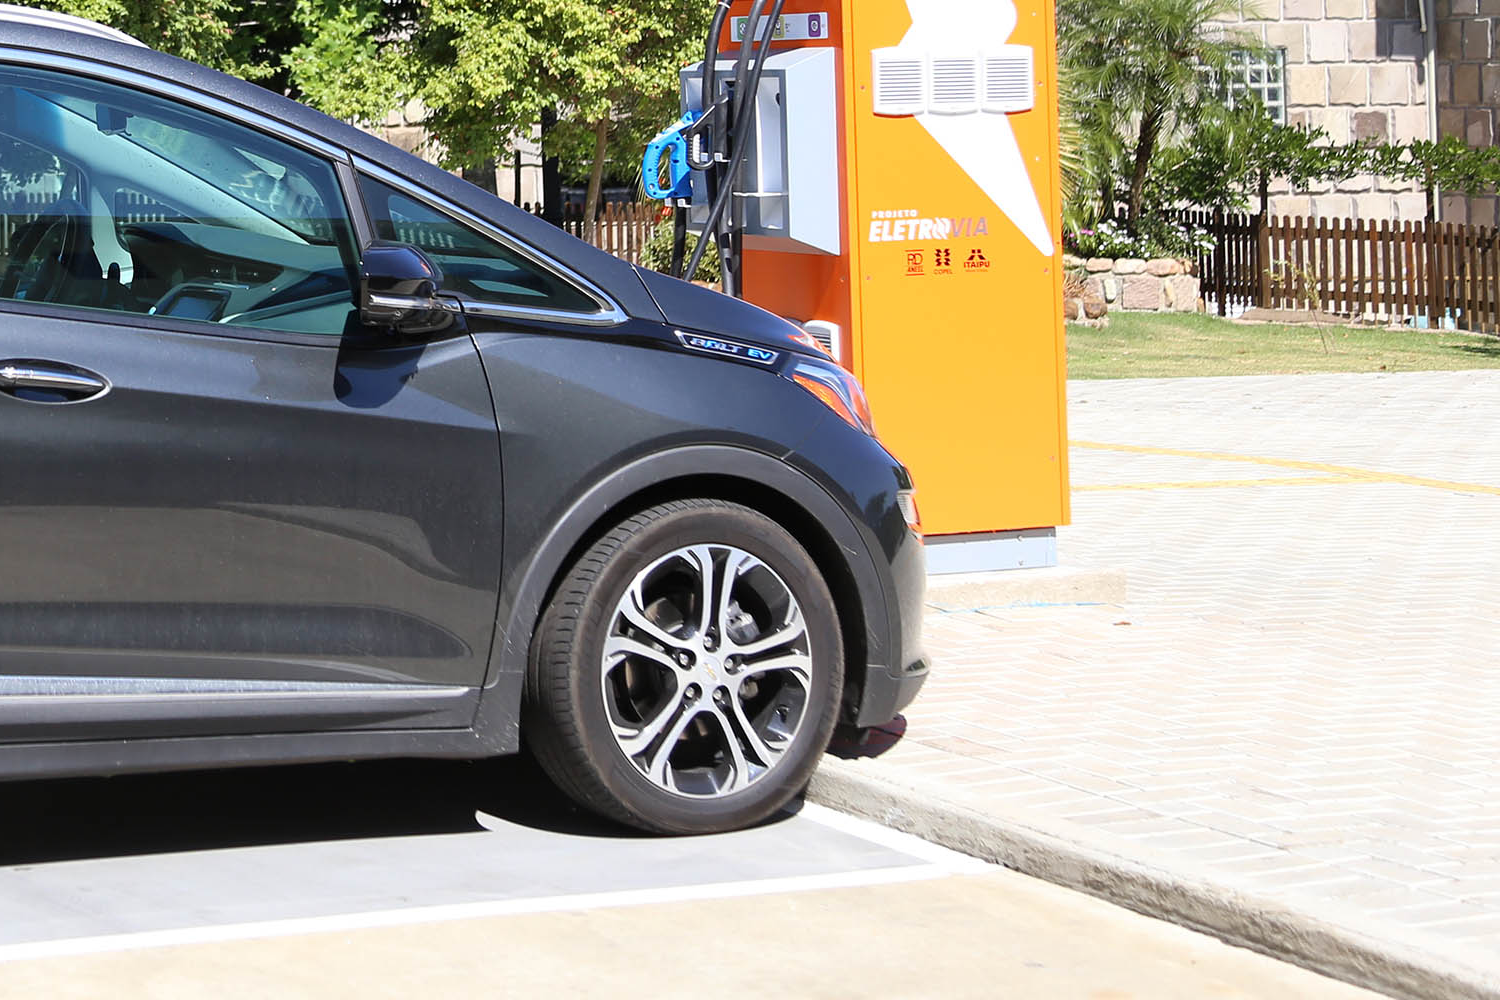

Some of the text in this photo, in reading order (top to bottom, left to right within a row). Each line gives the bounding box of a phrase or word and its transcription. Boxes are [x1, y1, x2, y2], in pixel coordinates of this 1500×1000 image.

[871, 209, 918, 218] PROJETO
[869, 217, 989, 242] ELETROVIA
[963, 260, 990, 269] ITAIPU
[747, 347, 771, 360] EV
